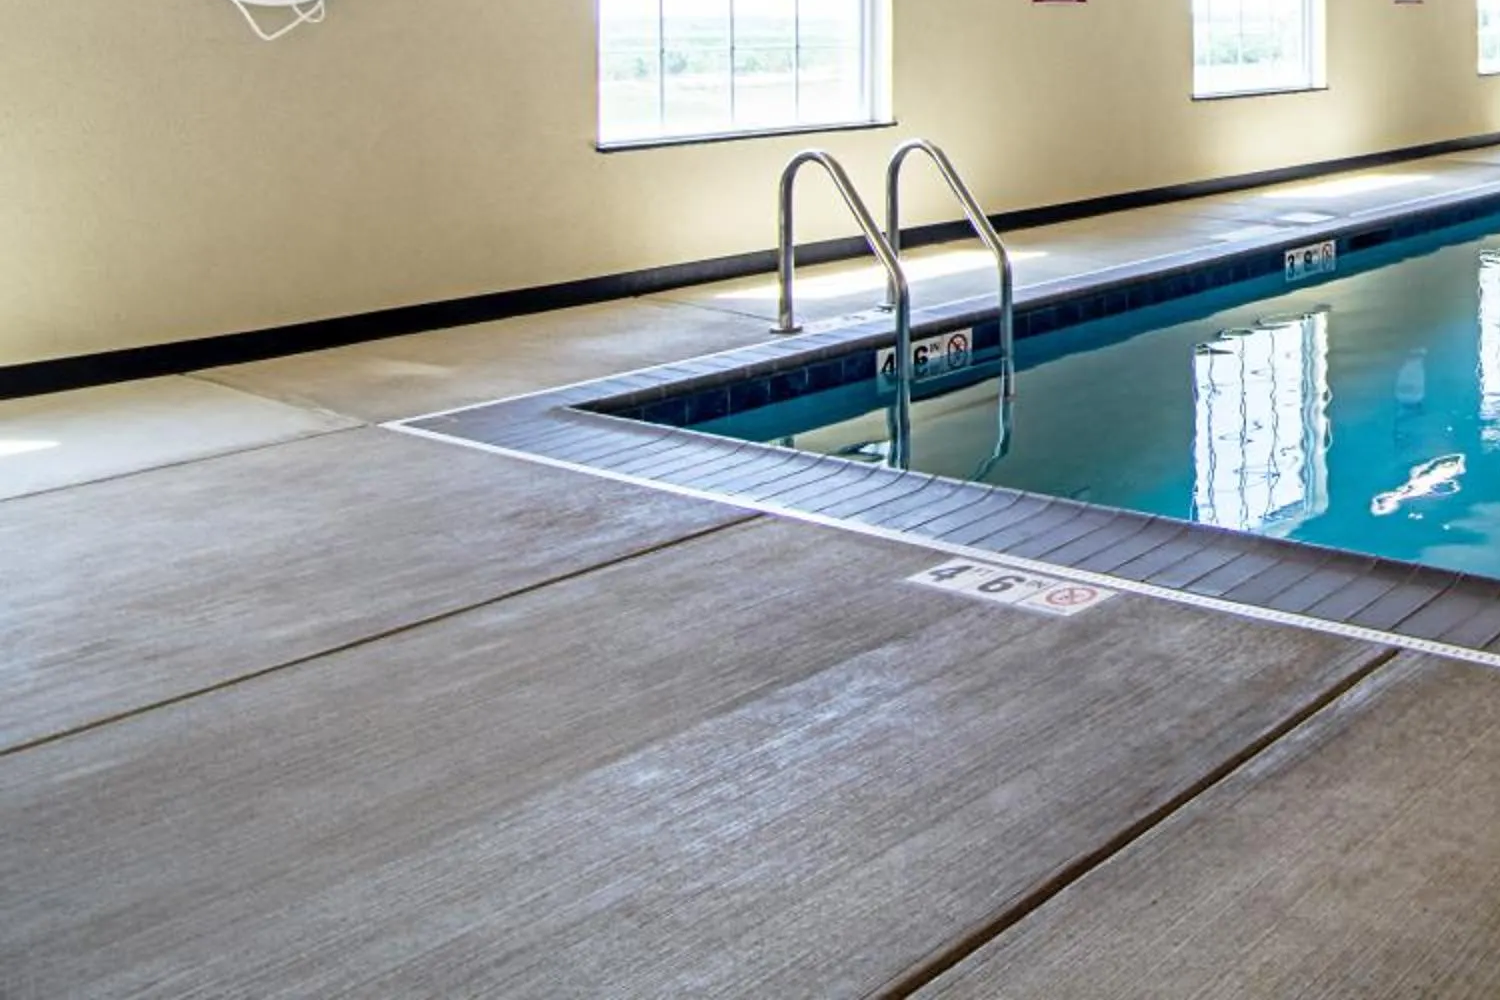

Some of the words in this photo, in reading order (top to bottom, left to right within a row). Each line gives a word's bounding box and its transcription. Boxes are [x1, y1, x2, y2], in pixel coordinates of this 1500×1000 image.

[913, 345, 928, 375] 6
[928, 565, 974, 582] 4
[977, 575, 1027, 593] 6
